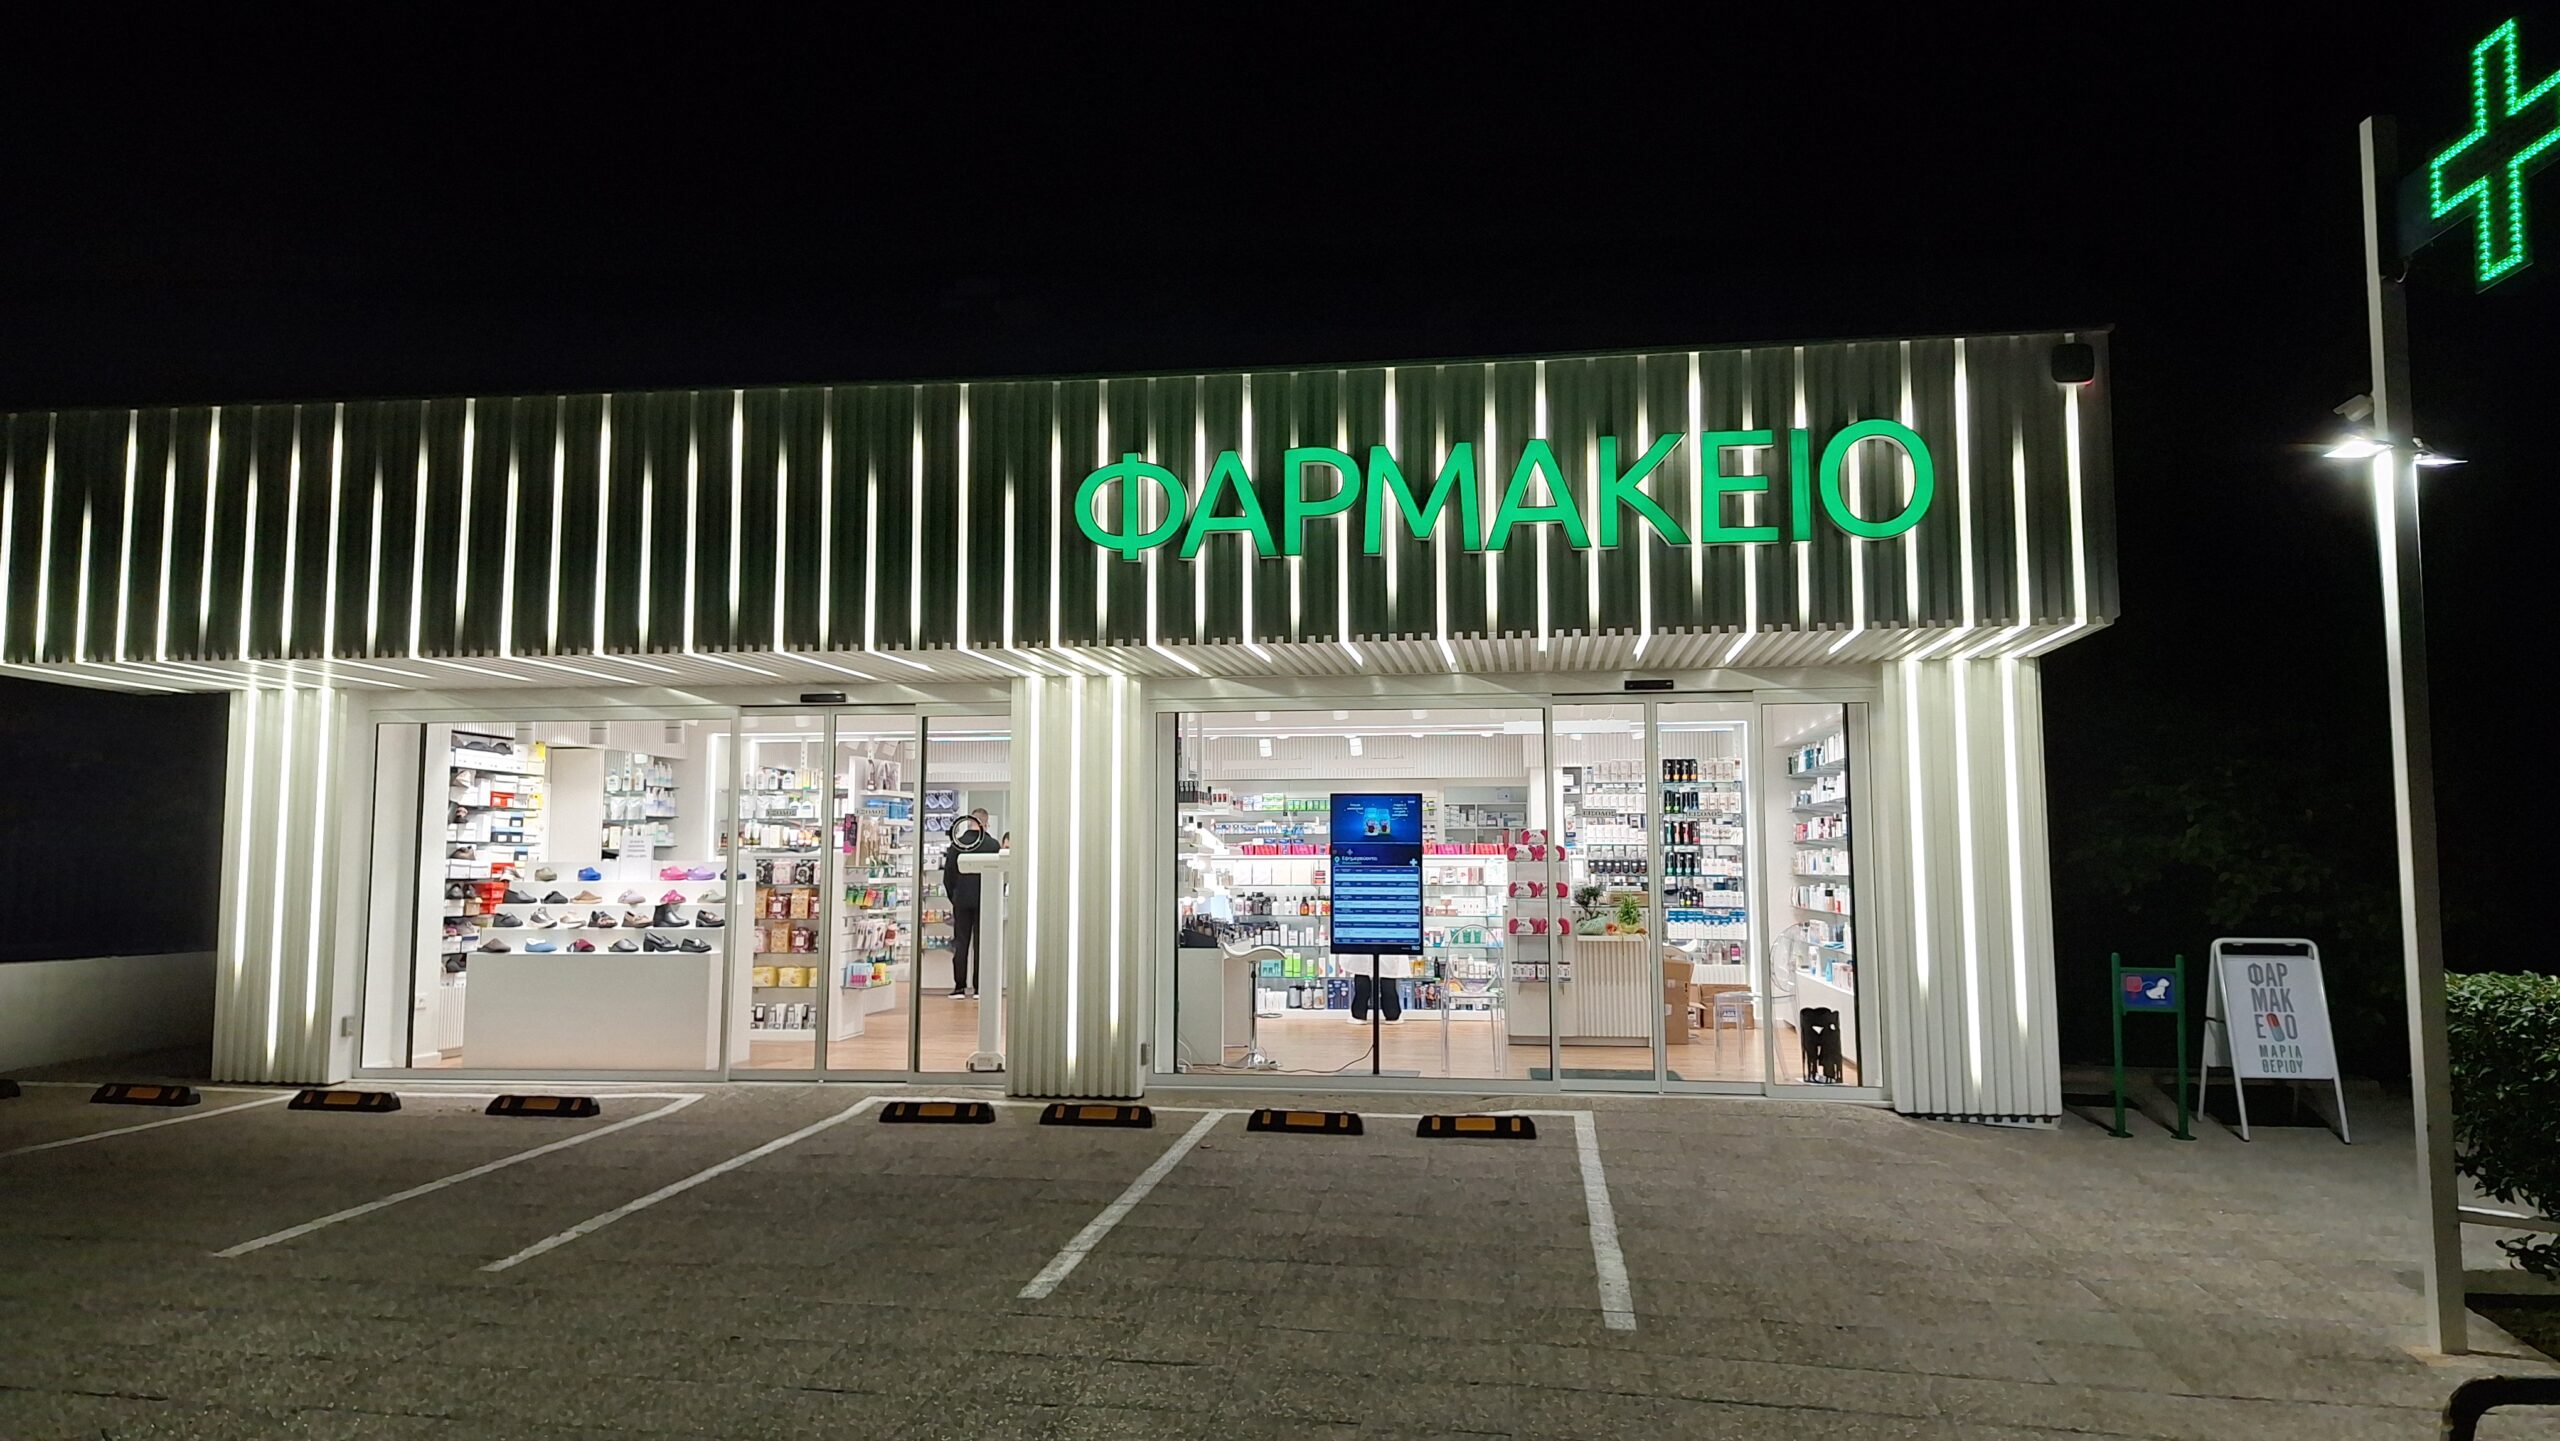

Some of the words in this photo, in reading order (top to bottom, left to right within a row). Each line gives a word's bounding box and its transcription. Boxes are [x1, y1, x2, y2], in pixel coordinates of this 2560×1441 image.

[1073, 419, 1936, 563] ΦΑΡΜΑΚΕΙΟ
[2247, 962, 2288, 987] ΦΑΡ
[2251, 988, 2295, 1012] ΜΑΚ
[2259, 1044, 2302, 1058] ΜΑΡΙΑ
[2262, 1059, 2304, 1074] ΘΕΡΙΟΥ
